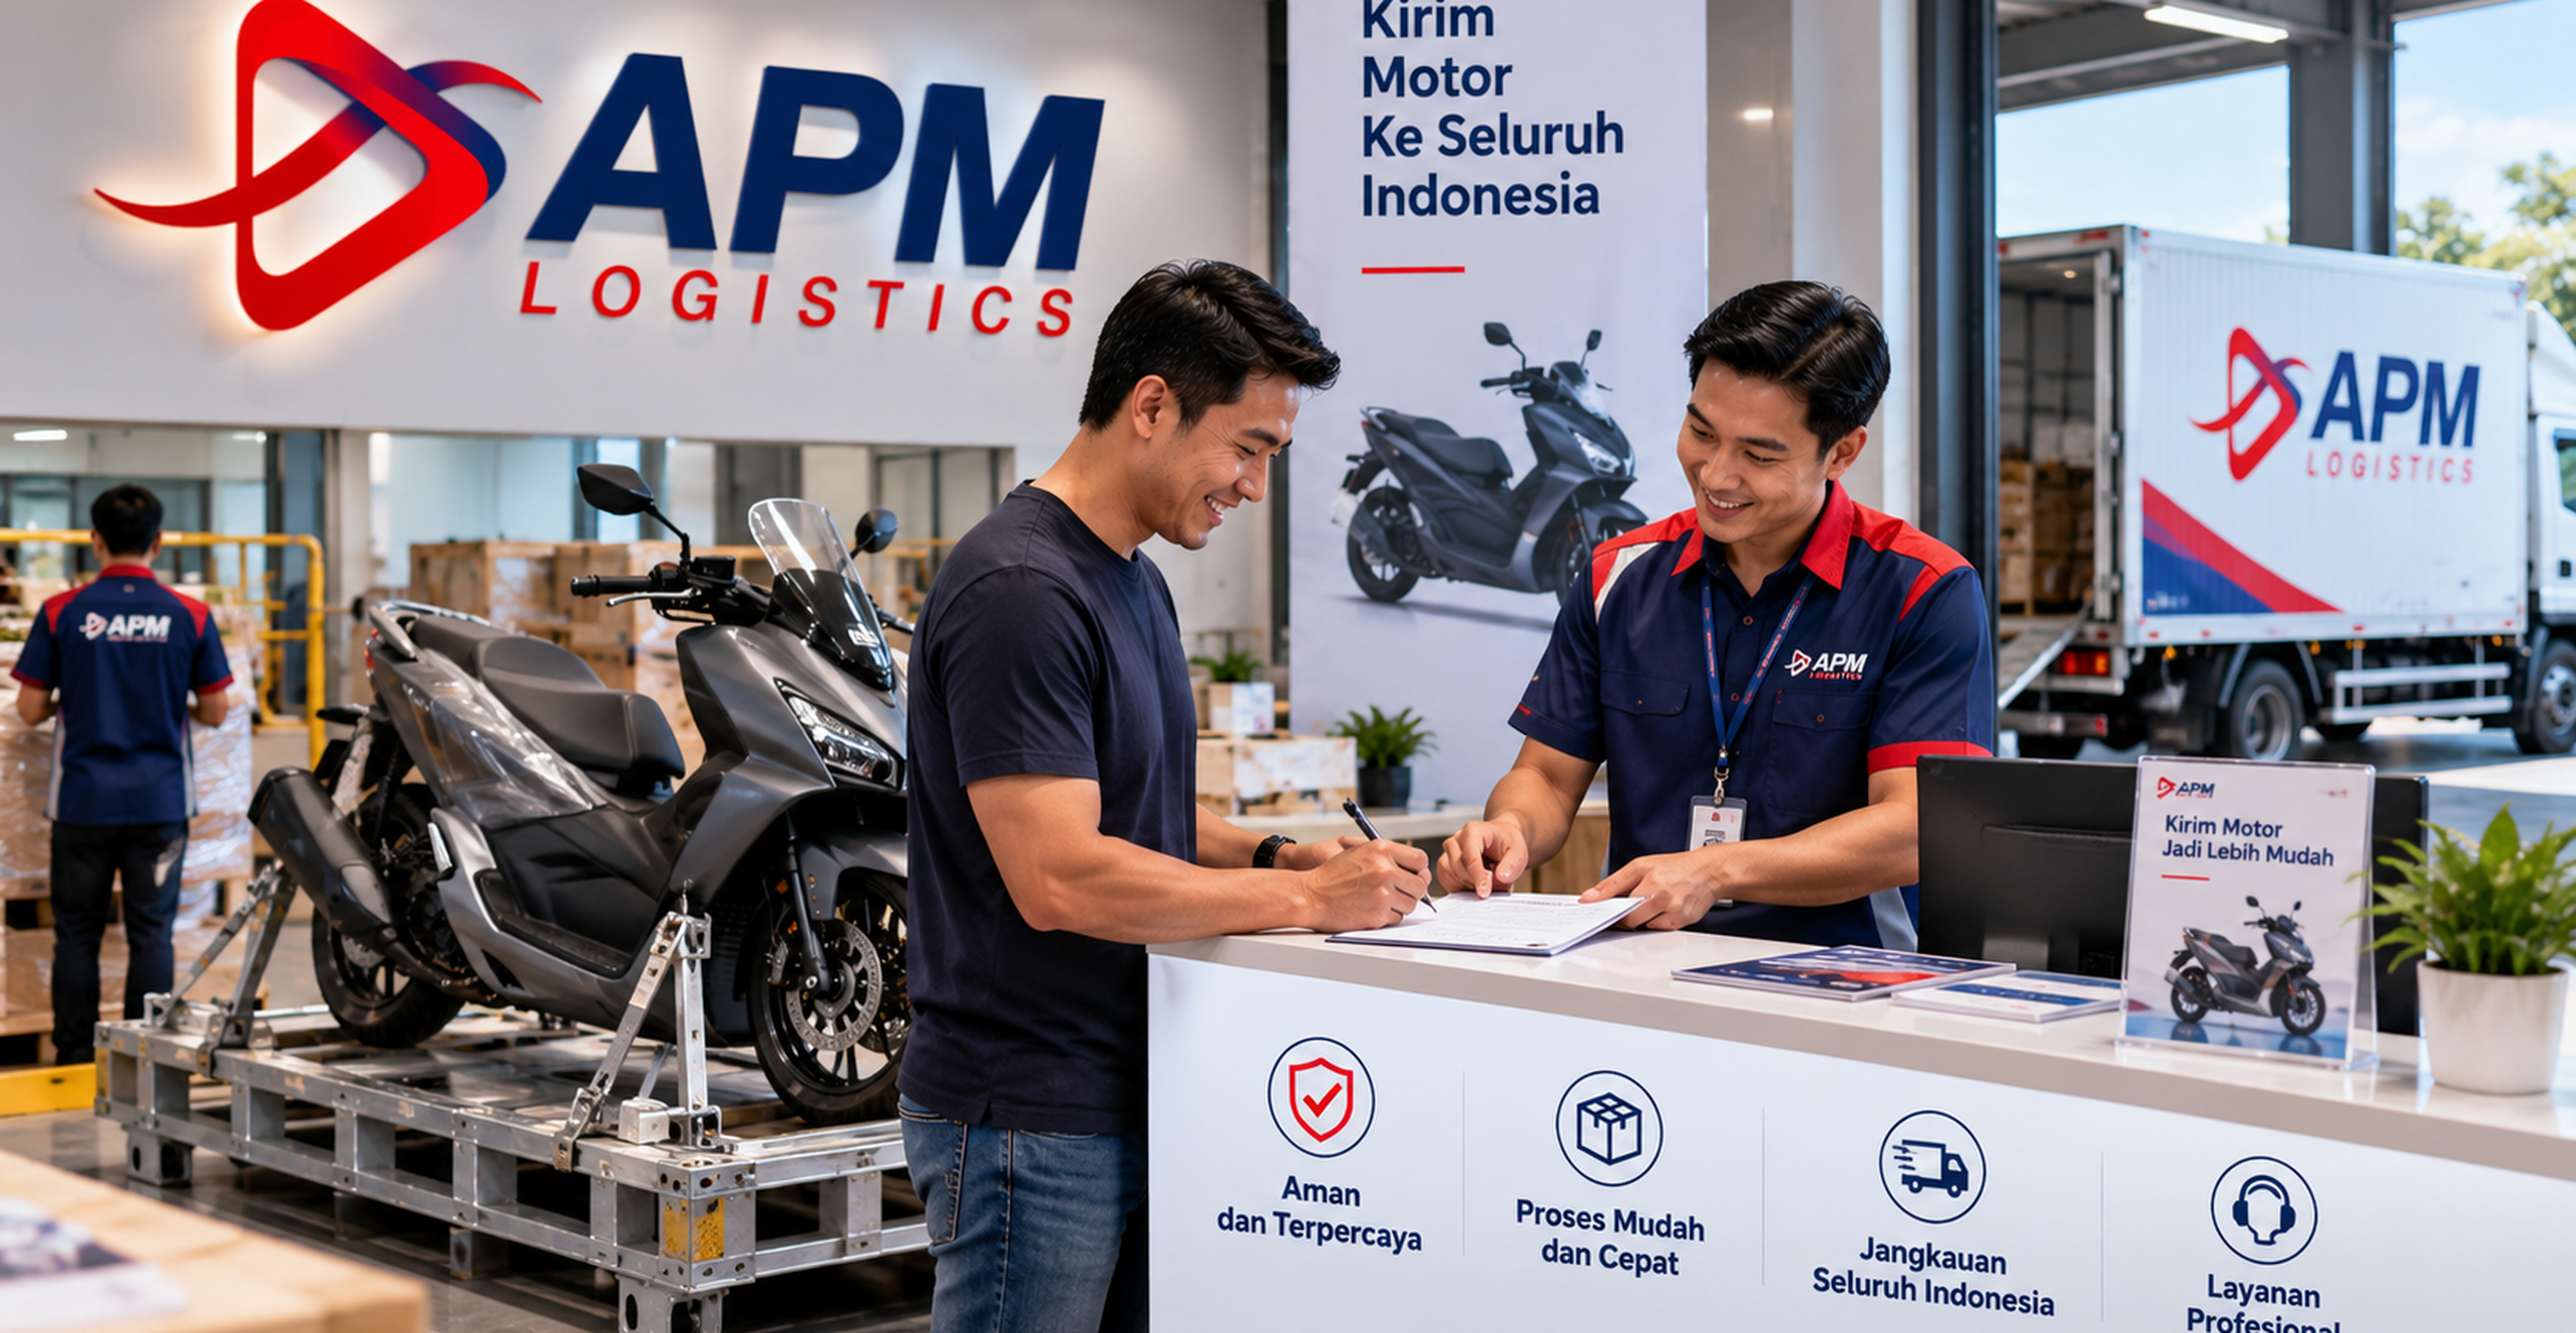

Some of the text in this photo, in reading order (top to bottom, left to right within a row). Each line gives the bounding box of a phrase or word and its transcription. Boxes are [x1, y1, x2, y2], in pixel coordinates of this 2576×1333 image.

[1363, 0, 1494, 39] Kirim
[1363, 55, 1513, 98] Motor
[1363, 110, 1624, 158] Ke Seluruh
[525, 52, 1106, 272] APM
[1363, 170, 1600, 217] Indonesia
[519, 261, 1074, 338] LOGISTICS
[2309, 350, 2481, 448] APM
[2306, 451, 2473, 484] LOGISTICS
[107, 614, 171, 638] APM
[1812, 653, 1868, 673] APM
[2176, 782, 2215, 798] APM
[2165, 814, 2283, 838] Kirim Motor
[2162, 839, 2334, 866] Jadi Lebih Mudah
[1281, 1175, 1361, 1207] Aman
[1217, 1206, 1422, 1255] dan Terpercaya
[1517, 1198, 1704, 1242] Proses Mudah
[1541, 1238, 1679, 1278] dan Cepat
[1859, 1236, 2007, 1275] Jangkauan
[1813, 1266, 2054, 1316] Seluruh Indonesia
[2208, 1273, 2320, 1309] Layanan
